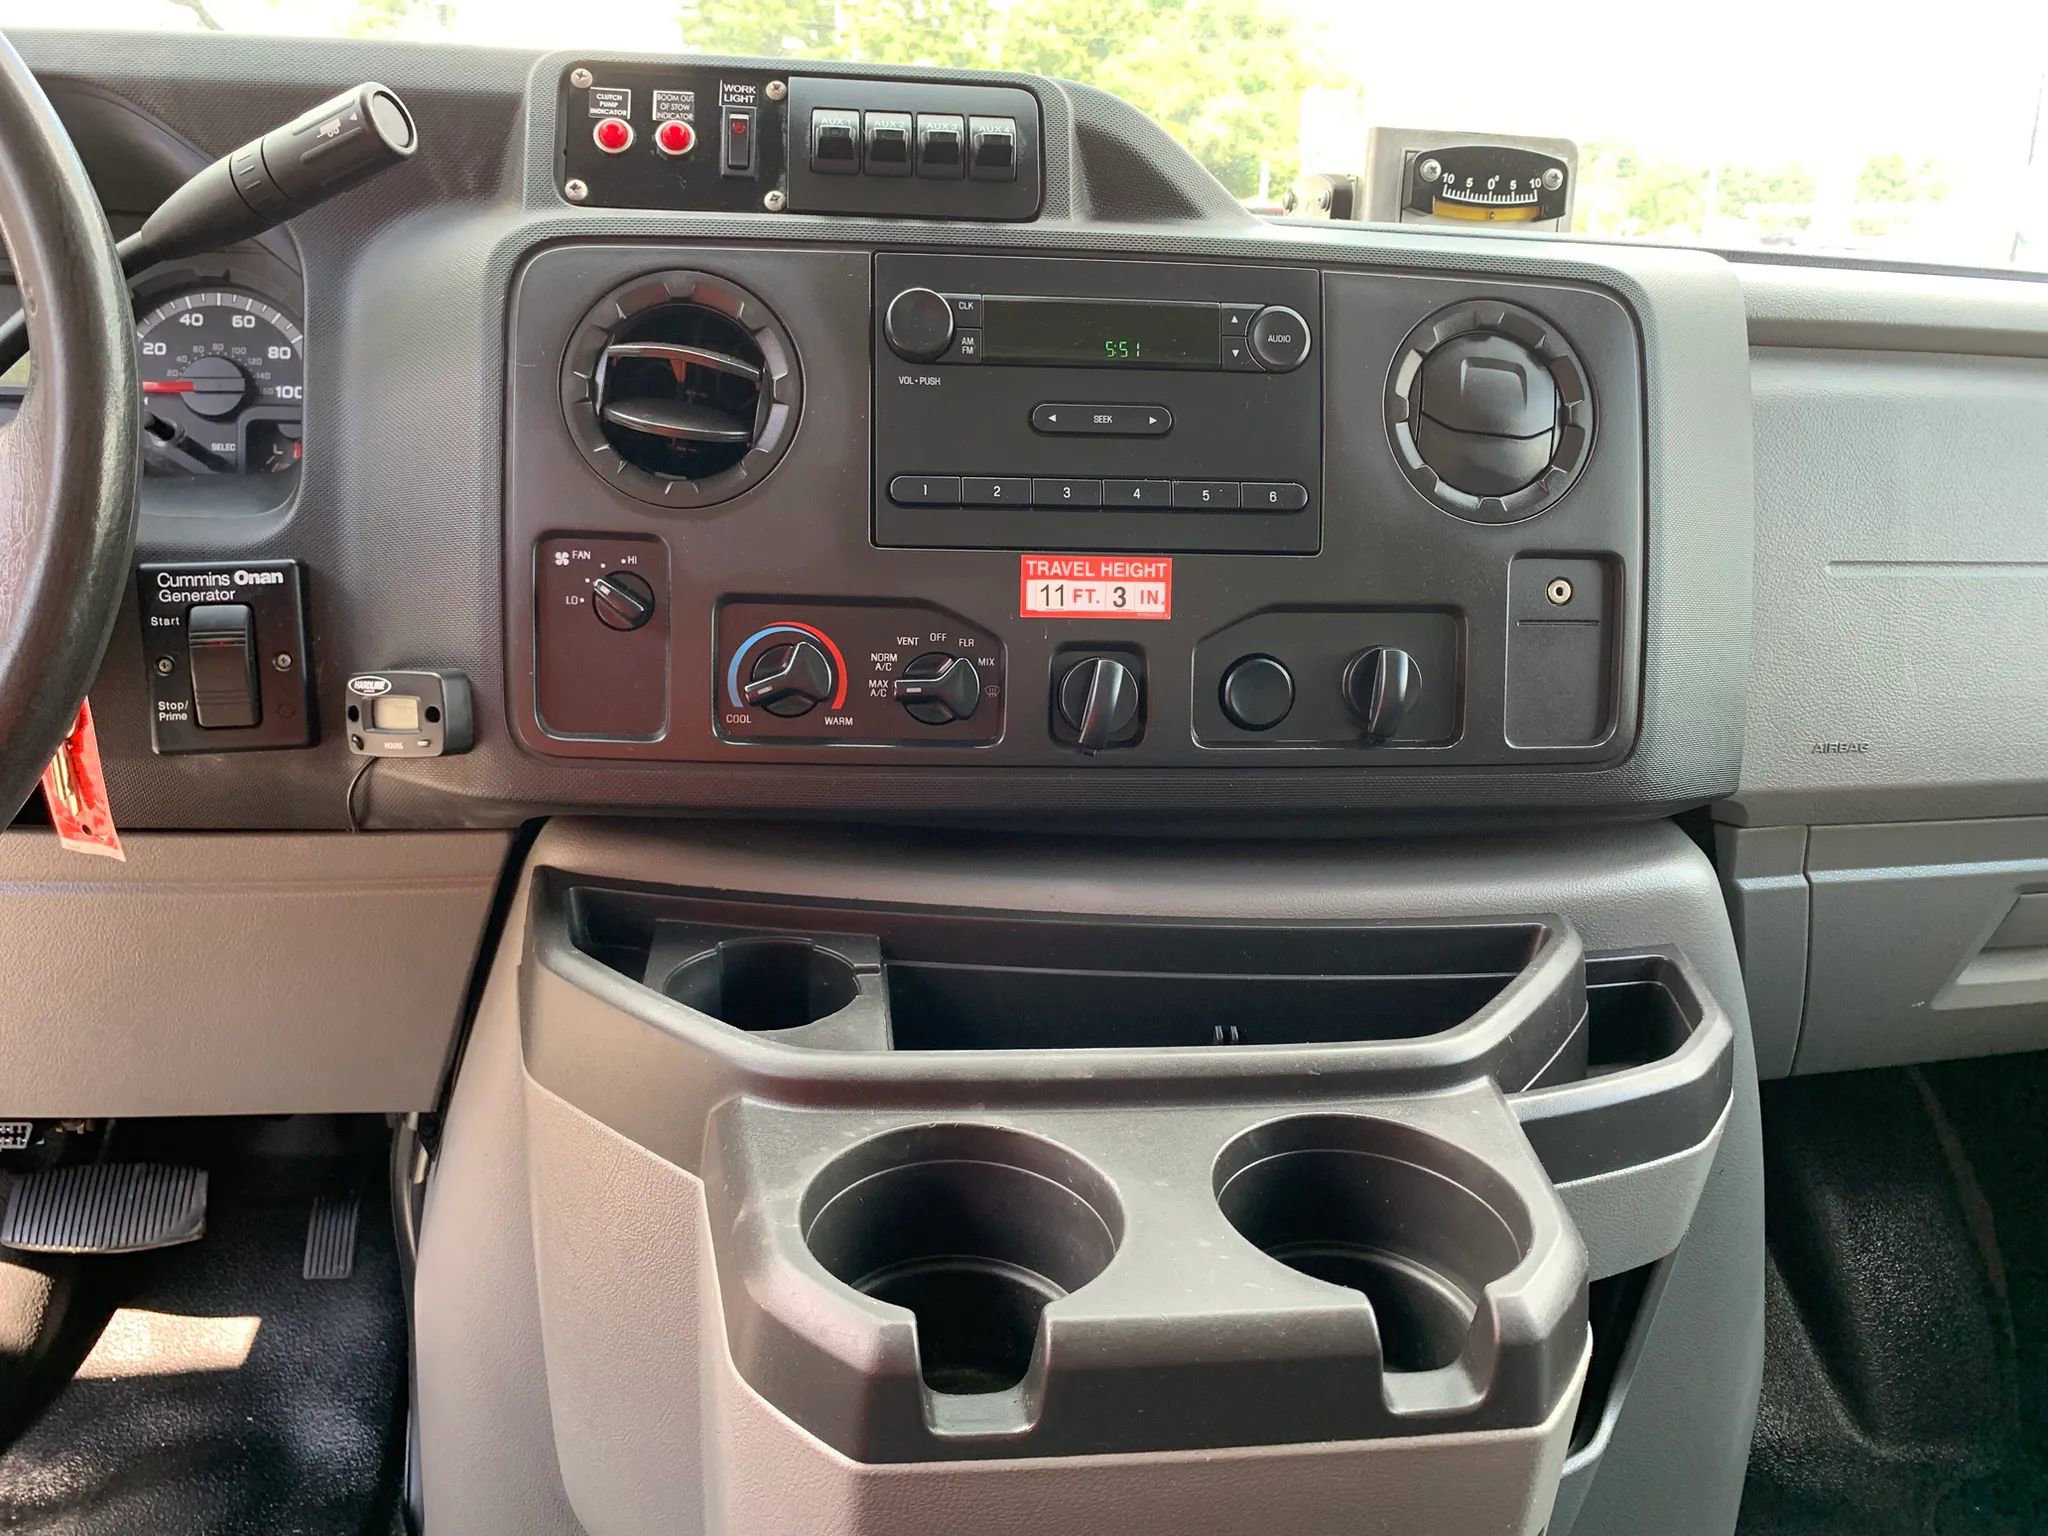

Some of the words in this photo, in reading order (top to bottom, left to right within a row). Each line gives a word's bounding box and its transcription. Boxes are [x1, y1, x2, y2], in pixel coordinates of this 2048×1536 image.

[724, 84, 756, 94] WORK
[596, 93, 623, 101] CLUTCH
[657, 94, 679, 102] BOOM
[680, 94, 694, 102] OUT
[724, 94, 754, 103] LIGHT
[590, 107, 627, 116] INDICATOR
[671, 103, 690, 111] STOW
[656, 111, 693, 121] INDICATOR
[821, 117, 845, 125] AUX
[874, 119, 897, 127] AUX
[898, 120, 905, 128] 2
[926, 122, 950, 130] AUX
[1442, 172, 1455, 184] 10
[1466, 177, 1473, 188] 5
[1510, 180, 1517, 190] 5
[1529, 177, 1541, 189] 10
[958, 301, 974, 310] CLK
[179, 313, 203, 326] 40
[232, 315, 255, 328] 60
[961, 337, 974, 346] AM
[1267, 334, 1291, 344] AUDIO
[143, 343, 166, 355] 20
[267, 346, 291, 359] 80
[961, 346, 974, 355] FM
[1105, 341, 1141, 358] 5:51
[899, 376, 915, 386] VOL
[919, 376, 941, 386] PUSH
[1093, 414, 1113, 424] SEEK
[922, 484, 928, 496] 1
[993, 486, 1001, 497] 2
[1063, 487, 1071, 499] 3
[1132, 488, 1141, 499] 4
[1202, 490, 1210, 501] 5
[1269, 491, 1277, 502] 6
[572, 550, 591, 560] FAN
[627, 555, 637, 565] HI
[1026, 560, 1095, 577] TRAVEL
[1101, 562, 1167, 578] HEIGHT
[157, 571, 230, 587] Cummins
[234, 569, 283, 585] Onan
[159, 588, 235, 603] Generator
[566, 595, 578, 605] LO
[1040, 583, 1064, 607] 11
[1112, 586, 1127, 608] 3
[151, 615, 180, 627] Start
[896, 636, 919, 646] VENT
[929, 632, 947, 642] OFF
[959, 638, 974, 647] FLR
[870, 653, 897, 662] NORM
[978, 658, 995, 666] MIX
[875, 662, 892, 671] A/C
[868, 680, 888, 688] MAX
[870, 688, 887, 697] A/C
[158, 700, 188, 713] Stop/
[159, 711, 188, 722] Prime
[726, 713, 752, 724] COOL
[824, 716, 853, 726] WARM
